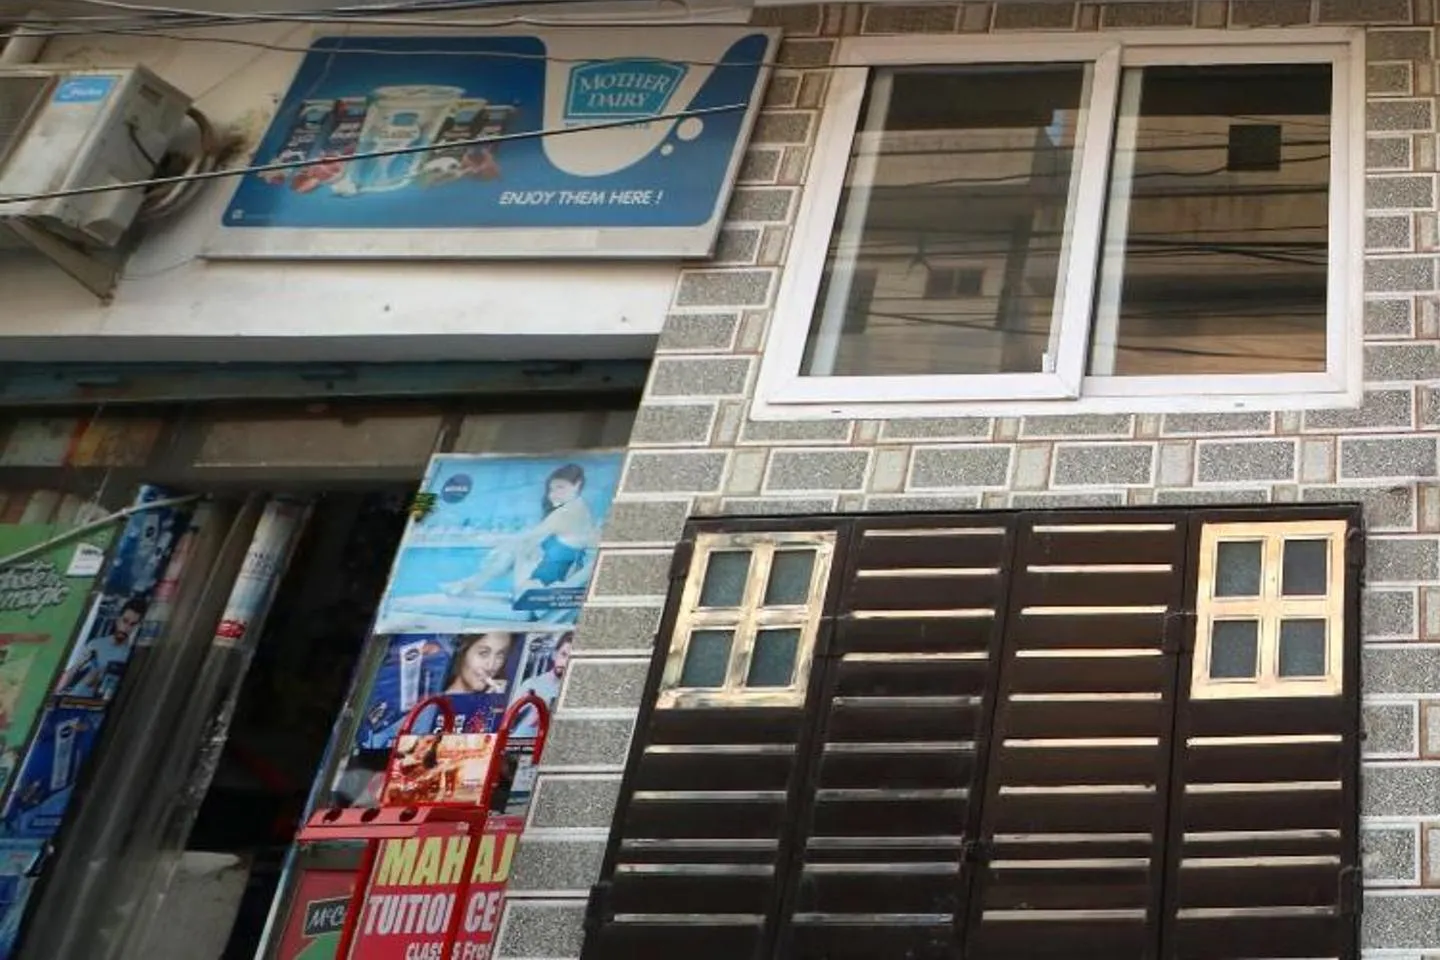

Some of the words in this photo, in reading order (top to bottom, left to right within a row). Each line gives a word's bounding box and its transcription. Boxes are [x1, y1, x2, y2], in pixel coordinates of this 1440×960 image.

[580, 72, 670, 93] MOTHER
[587, 91, 651, 107] DAIRY
[499, 190, 555, 206] ENJOY
[557, 190, 606, 206] THEM
[608, 190, 651, 206] HERE
